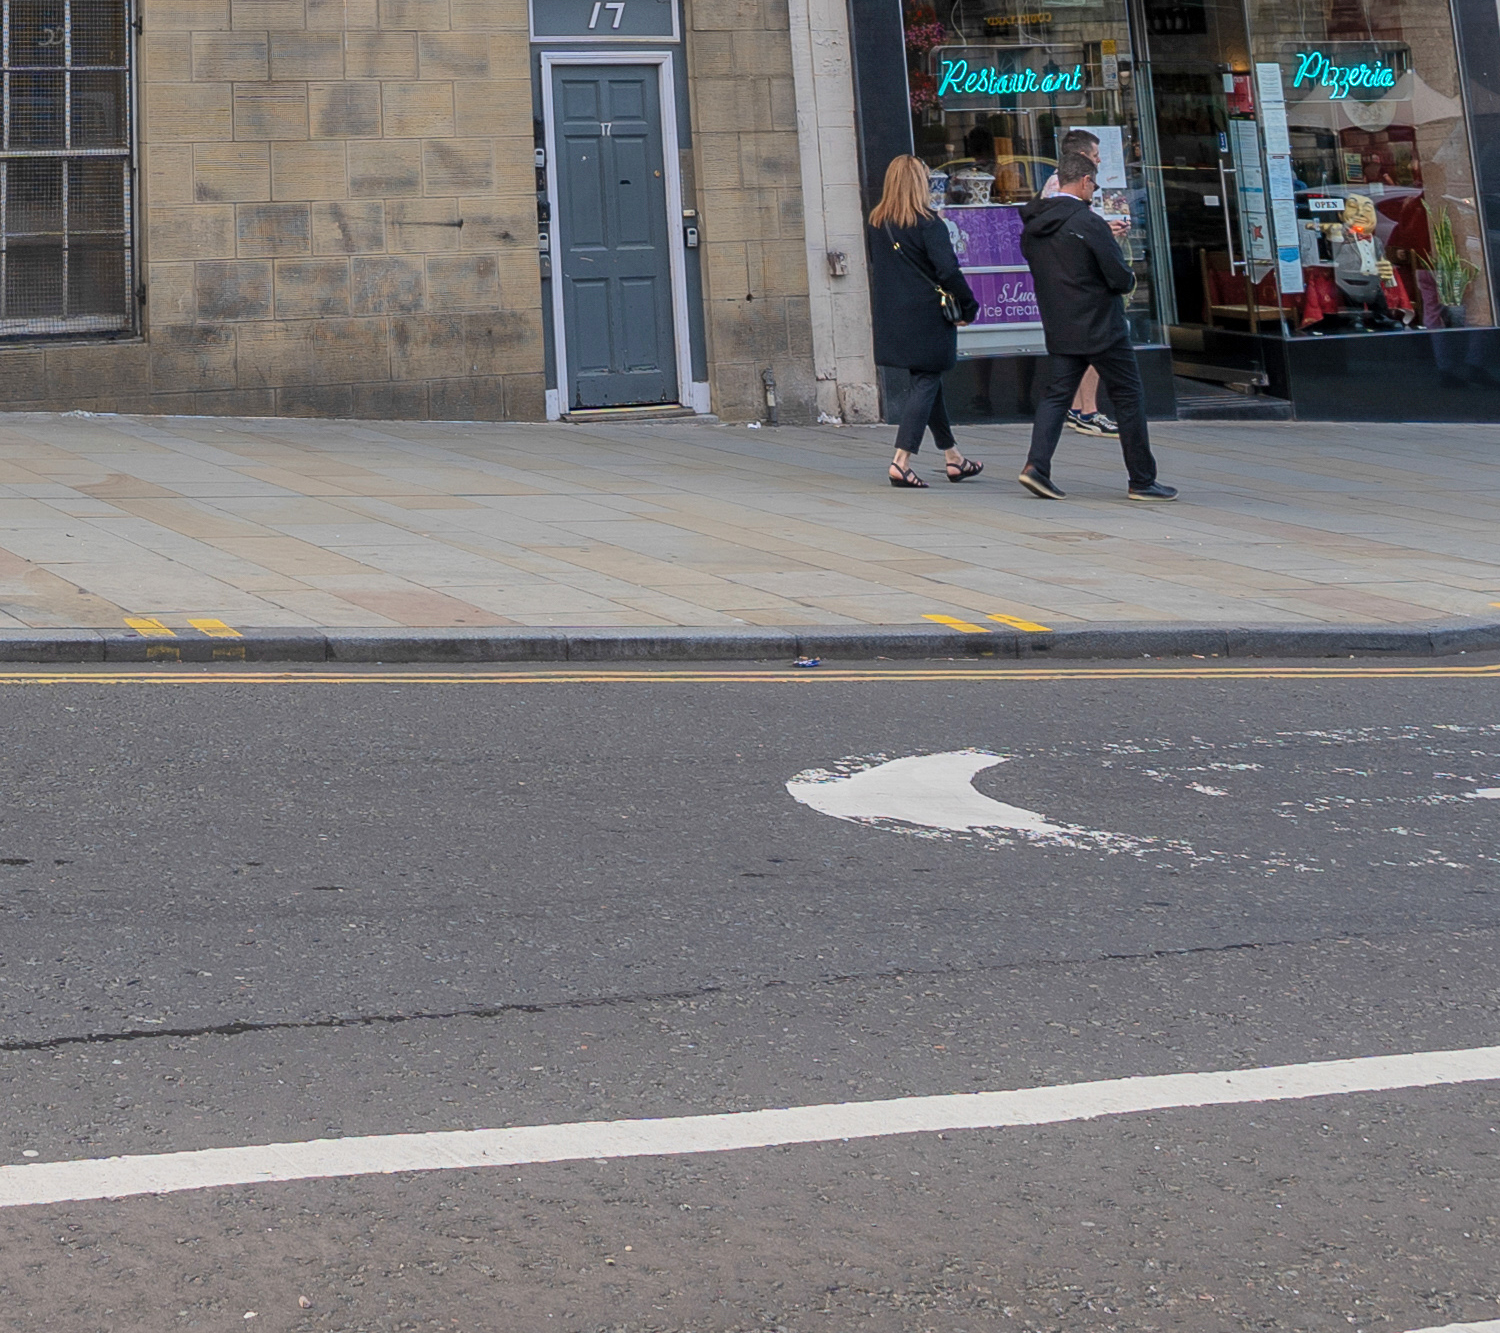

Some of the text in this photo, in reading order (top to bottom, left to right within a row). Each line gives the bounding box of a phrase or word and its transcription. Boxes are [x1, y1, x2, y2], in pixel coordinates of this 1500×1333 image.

[588, 1, 625, 29] 17
[937, 60, 1081, 97] Restaurant
[1293, 51, 1395, 100] Pizzeria
[600, 122, 612, 136] 17
[1315, 201, 1338, 209] OPEN
[984, 304, 1003, 317] ice
